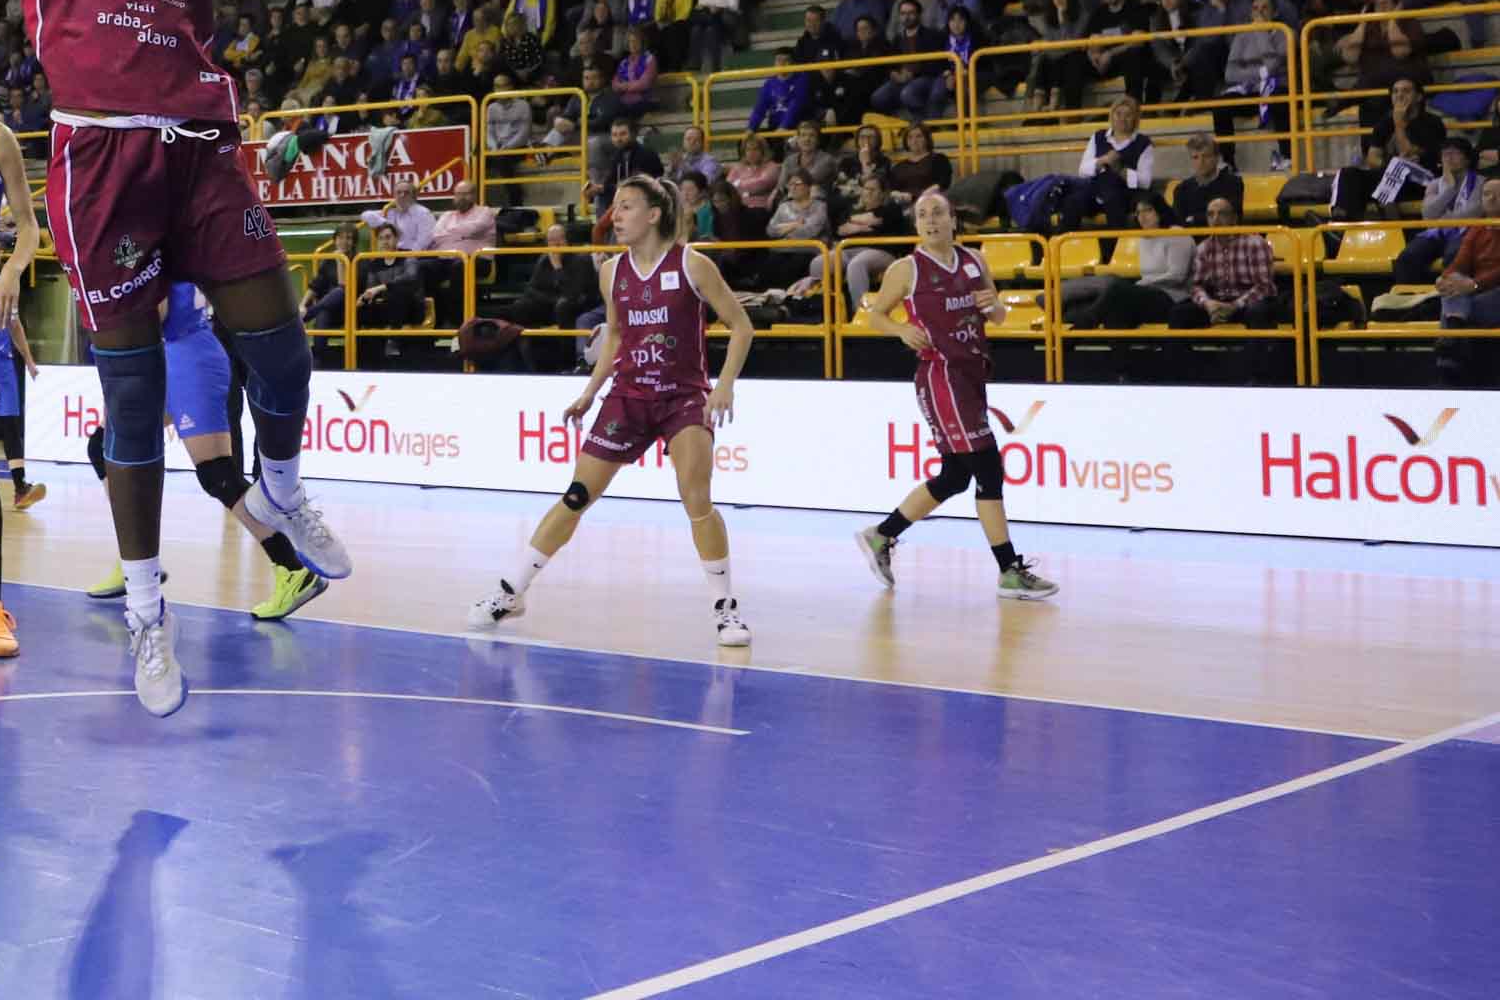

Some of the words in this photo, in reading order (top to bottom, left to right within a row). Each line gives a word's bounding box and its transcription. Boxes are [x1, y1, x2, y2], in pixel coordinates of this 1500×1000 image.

[126, 1, 156, 14] visit
[97, 12, 141, 29] araba
[278, 178, 301, 201] LA
[243, 205, 271, 240] 42
[88, 290, 109, 304] EL
[628, 306, 669, 326] ARASKI
[390, 429, 461, 466] viajes
[1070, 457, 1174, 502] viajes
